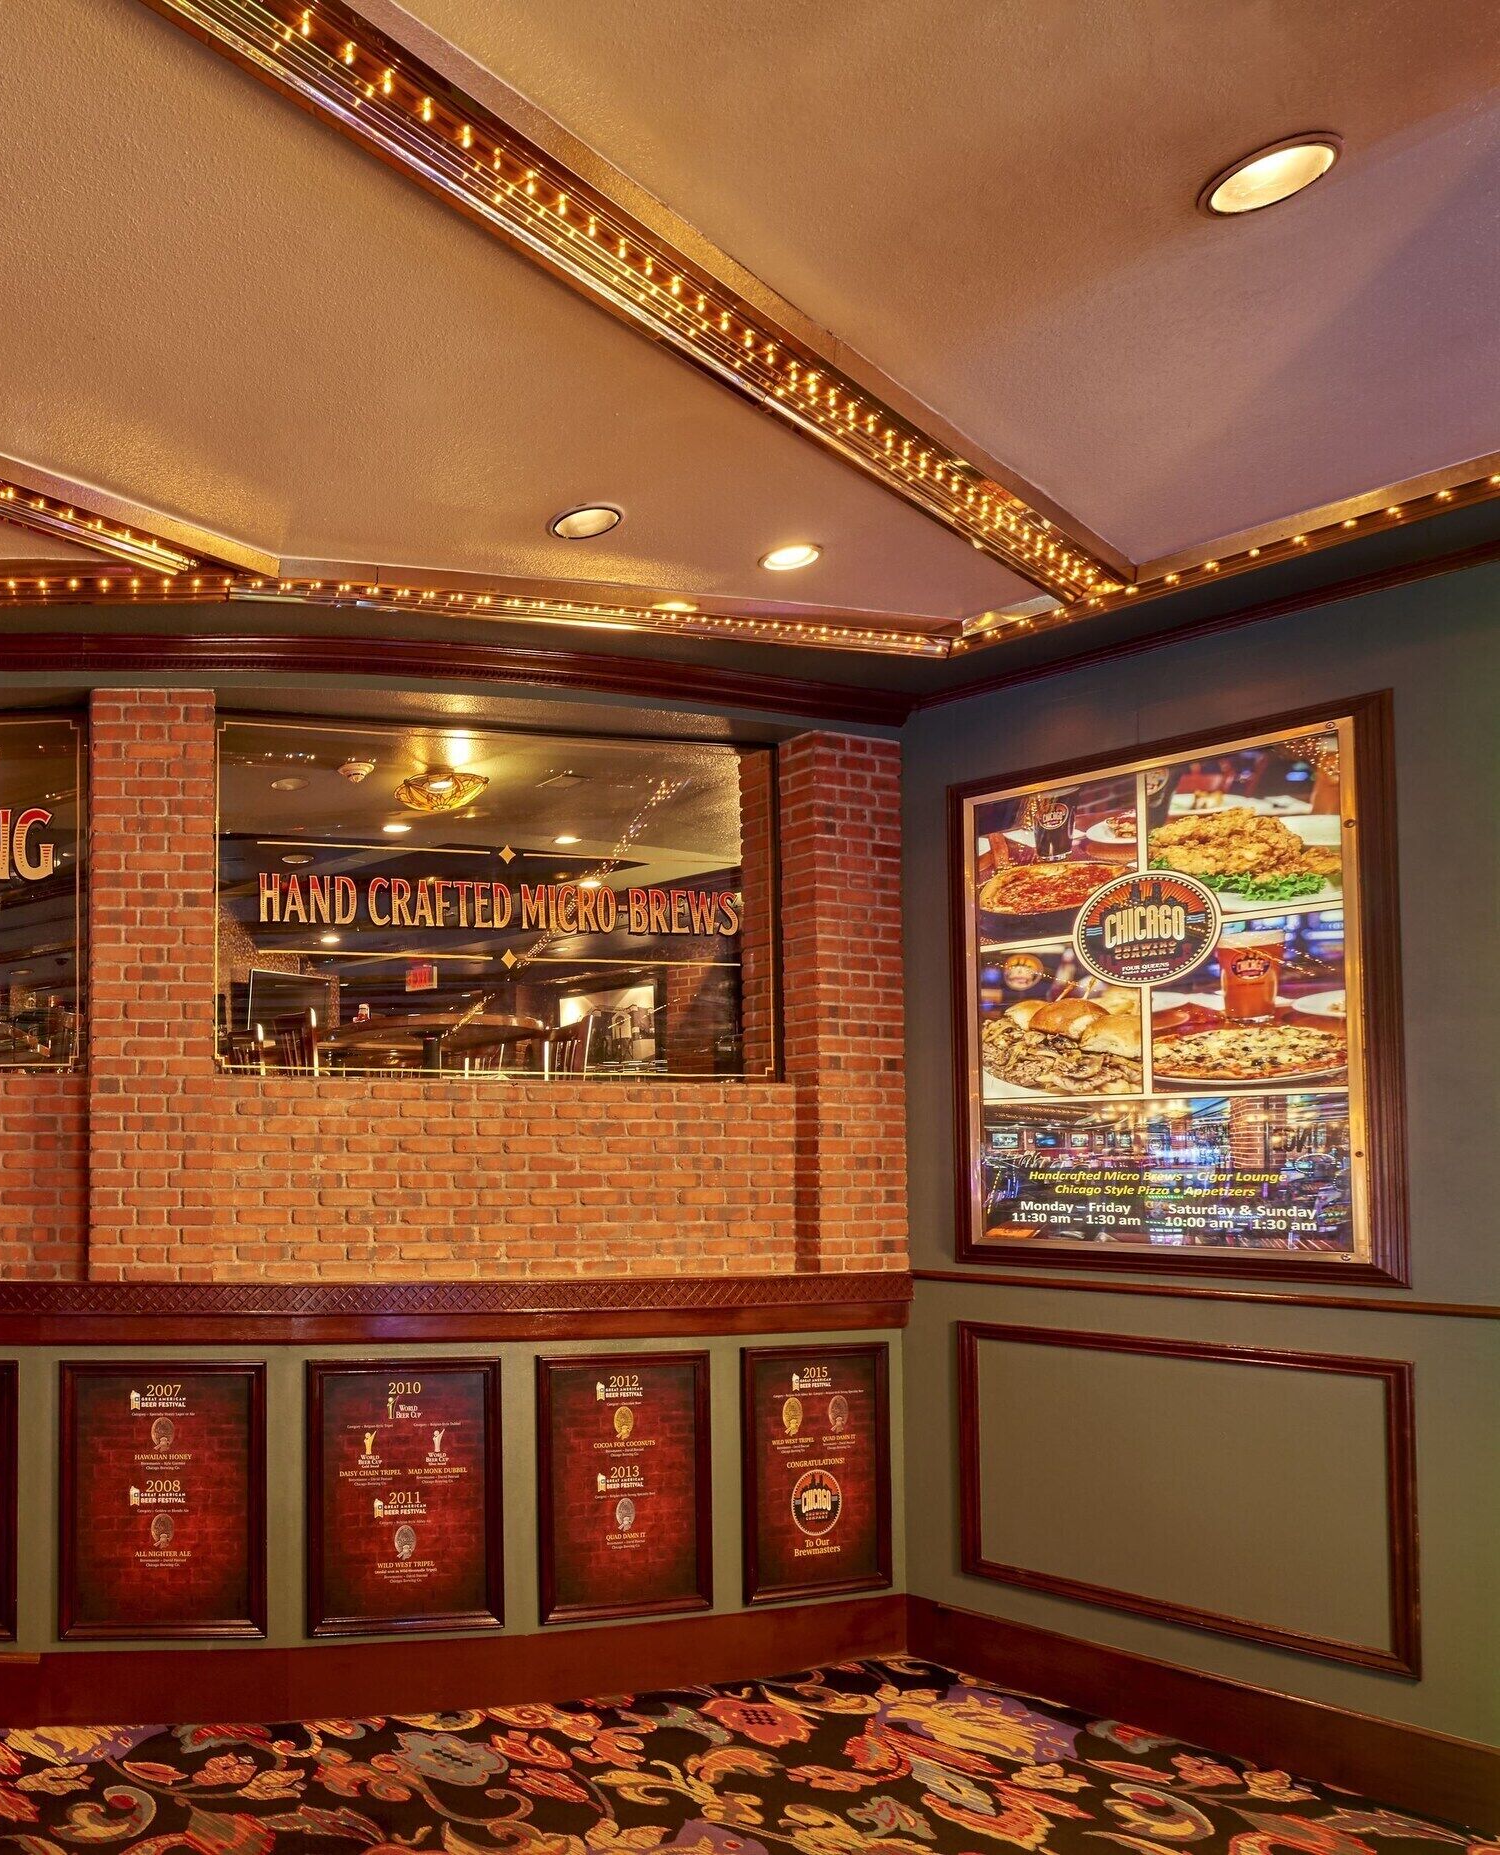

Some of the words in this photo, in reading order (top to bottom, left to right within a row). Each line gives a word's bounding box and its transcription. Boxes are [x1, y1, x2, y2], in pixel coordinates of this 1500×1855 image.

[258, 872, 358, 925] HAND
[368, 876, 512, 930] CRAFTED
[520, 883, 739, 937] MICRO-BREWS
[1105, 905, 1185, 949] CHICAGO
[1115, 940, 1177, 953] BREWING
[1115, 948, 1176, 959] COMPANY
[1029, 1171, 1100, 1182] Handcrafted
[1104, 1171, 1139, 1180] Micro
[1143, 1172, 1182, 1181] Brews
[1197, 1172, 1233, 1183] Cigar
[1236, 1172, 1287, 1184] Lounge
[1055, 1185, 1101, 1196] Chicago
[1104, 1185, 1134, 1196] Style
[1138, 1185, 1170, 1195] Pizza
[1184, 1187, 1256, 1198] Appetizers
[1021, 1201, 1074, 1213] Monday
[1089, 1203, 1131, 1215] Friday
[1169, 1204, 1235, 1218] Saturday
[1240, 1206, 1252, 1216] &
[1257, 1206, 1316, 1219] Sunday
[1012, 1213, 1047, 1223] 11:30
[1050, 1215, 1071, 1223] am
[1086, 1215, 1115, 1225] 1:30
[1119, 1217, 1140, 1226] am
[1165, 1217, 1205, 1227] 10:00
[1210, 1219, 1233, 1229] am
[1252, 1220, 1286, 1230] 1:30
[1291, 1222, 1317, 1231] am
[803, 1367, 827, 1378] 2015
[610, 1375, 639, 1387] 2012
[147, 1385, 181, 1396] 2007
[388, 1382, 421, 1394] 2010
[787, 1458, 845, 1468] CONGRATULATIONS!
[611, 1466, 639, 1478] 2013
[146, 1480, 180, 1492] 2008
[389, 1492, 421, 1504] 2011
[802, 1489, 831, 1513] CHICAGO
[795, 1546, 841, 1557] Brewmasters
